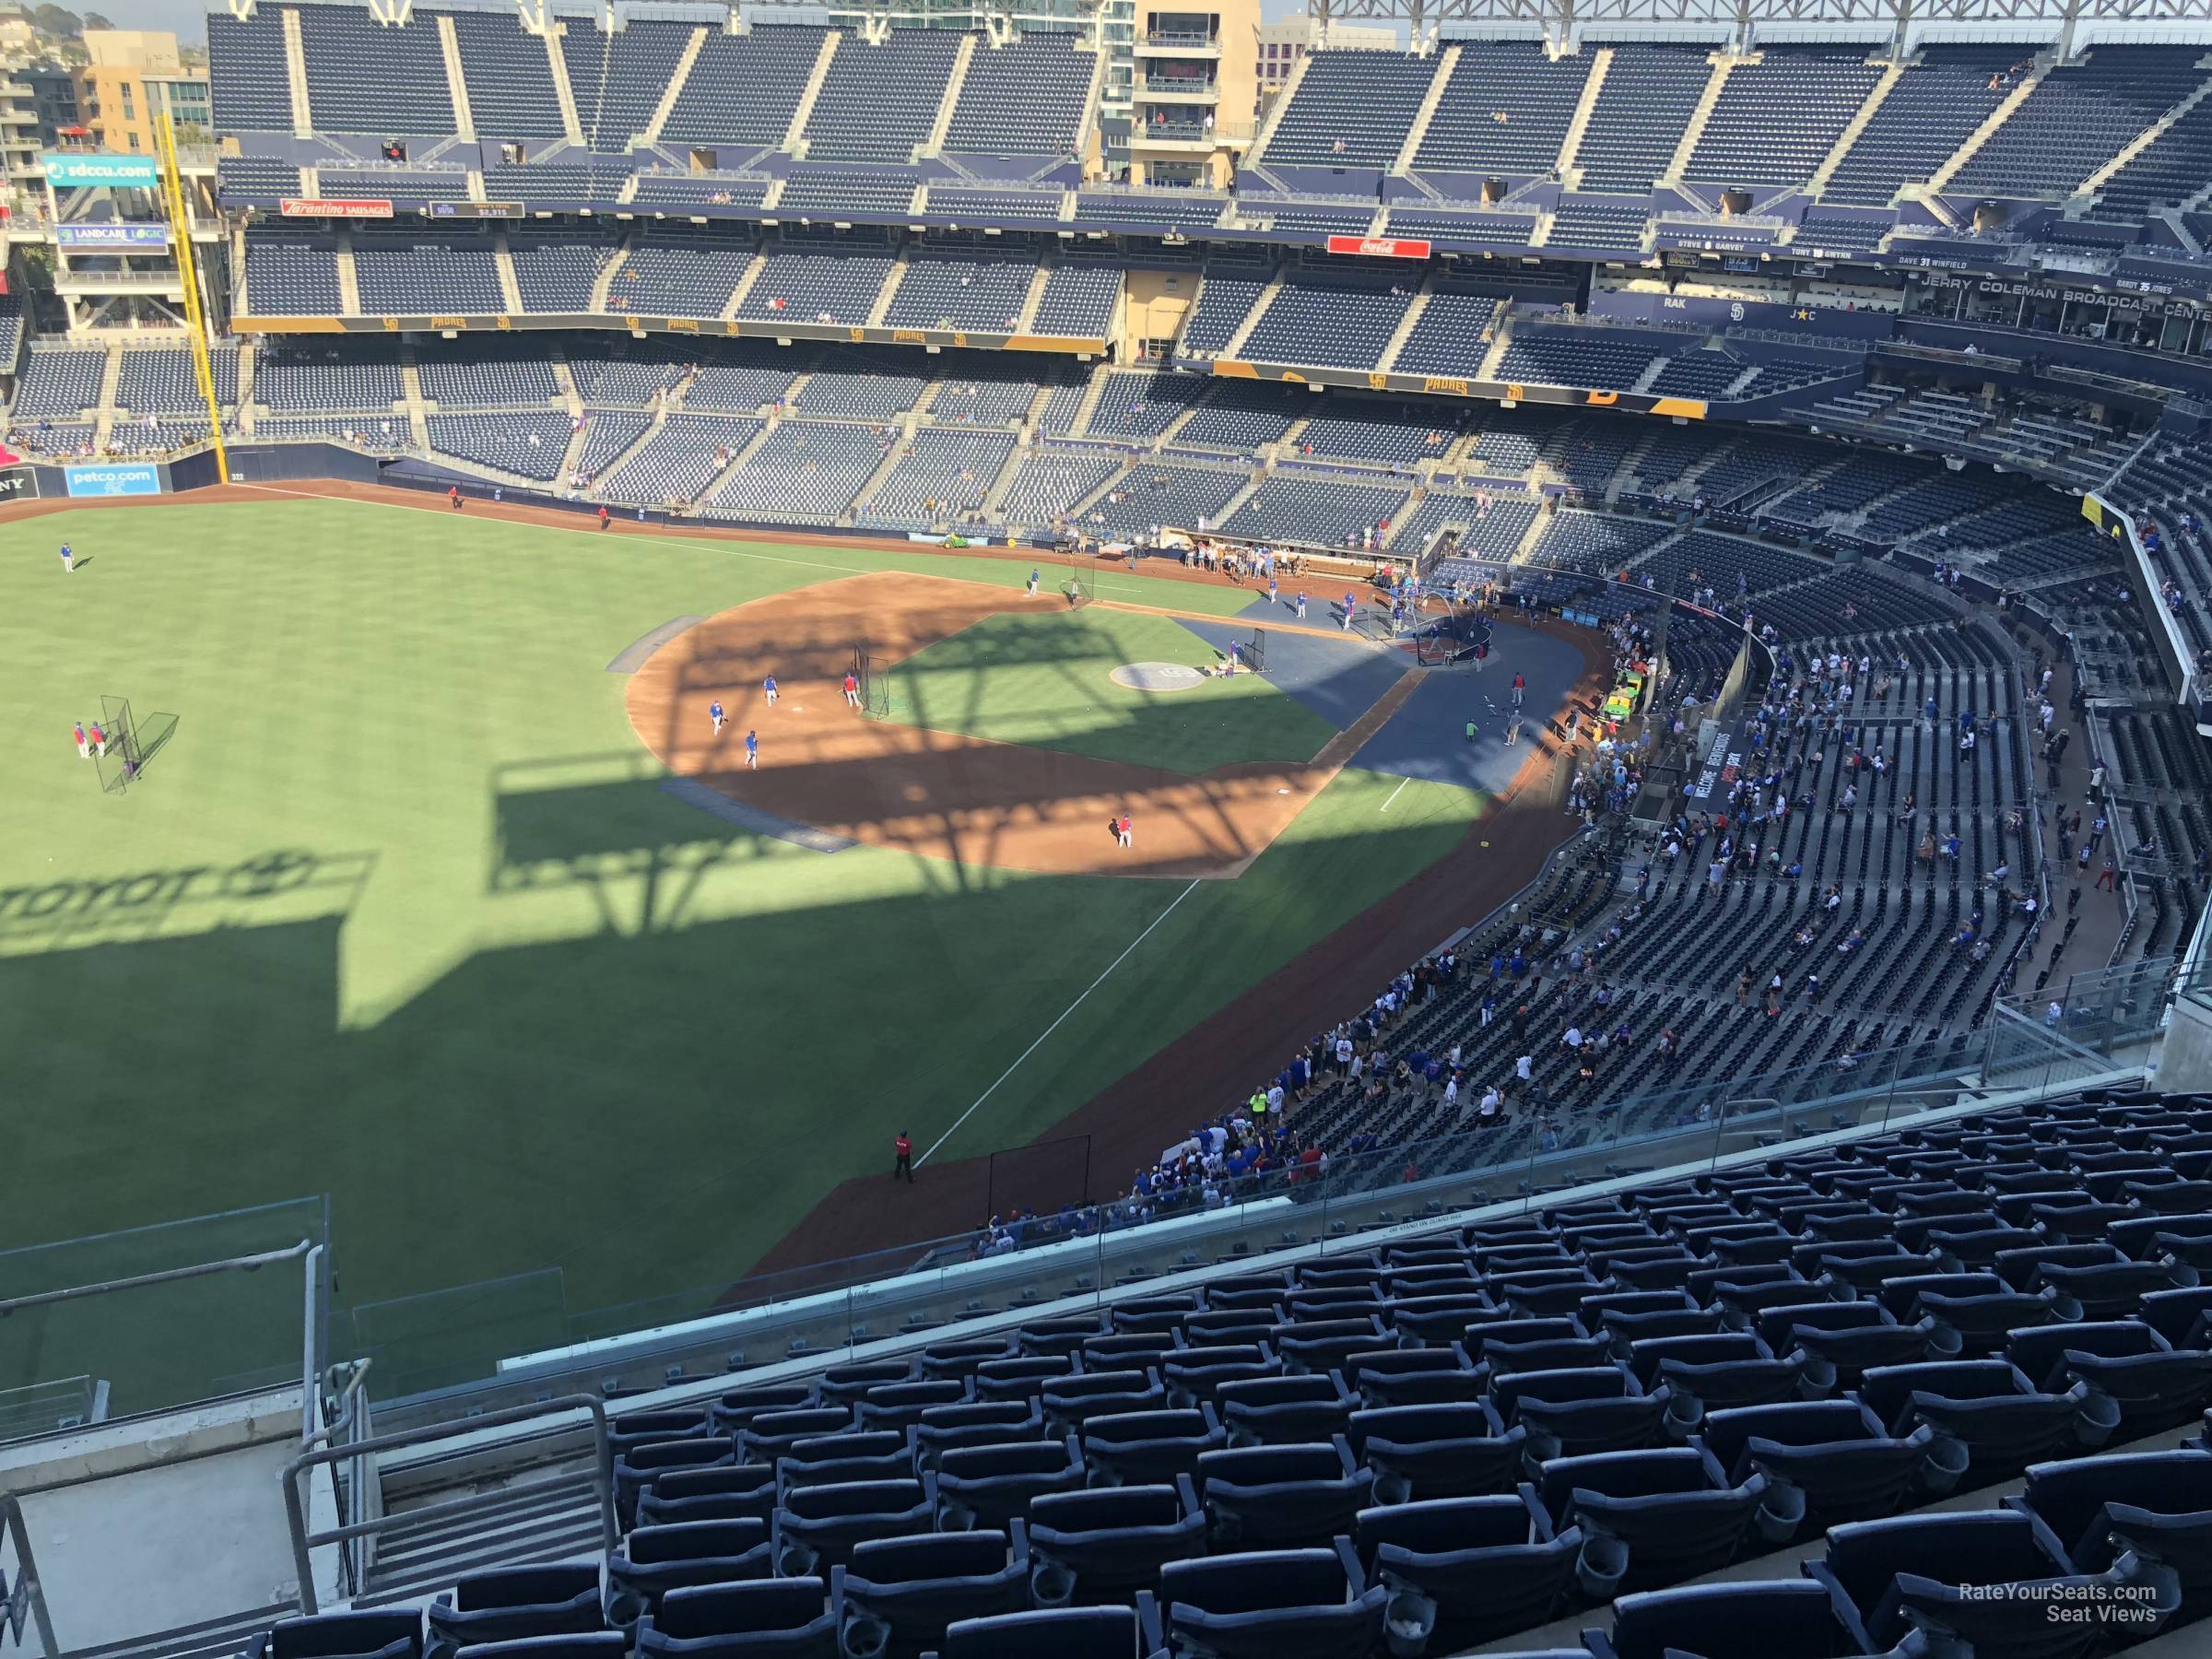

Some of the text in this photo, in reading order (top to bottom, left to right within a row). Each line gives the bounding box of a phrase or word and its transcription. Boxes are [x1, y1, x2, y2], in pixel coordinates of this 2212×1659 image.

[68, 162, 151, 177] sdccu.com
[284, 201, 391, 215] Tarantino SAUSAGES
[75, 229, 164, 239] LANDCARE LOGIC
[1677, 241, 1701, 249] STEVE
[1715, 242, 1745, 252] GARVEY
[1792, 248, 1810, 256] TONY
[1899, 256, 1968, 269] DAVE 31 WINFIELD
[2115, 279, 2173, 295] RANDY 35 JONES
[1664, 297, 1687, 309] RAK
[1921, 276, 2212, 322] JERRY COLEMAN BROADCAST CENTE
[1730, 302, 1746, 322] SD
[431, 316, 467, 330] PADRES
[668, 318, 700, 332] PADRES
[893, 330, 926, 344] PADRES
[1423, 378, 1468, 396] PADRES
[0, 478, 25, 491] NY
[74, 471, 151, 485] petco.com
[1694, 771, 1717, 797] WELCOME
